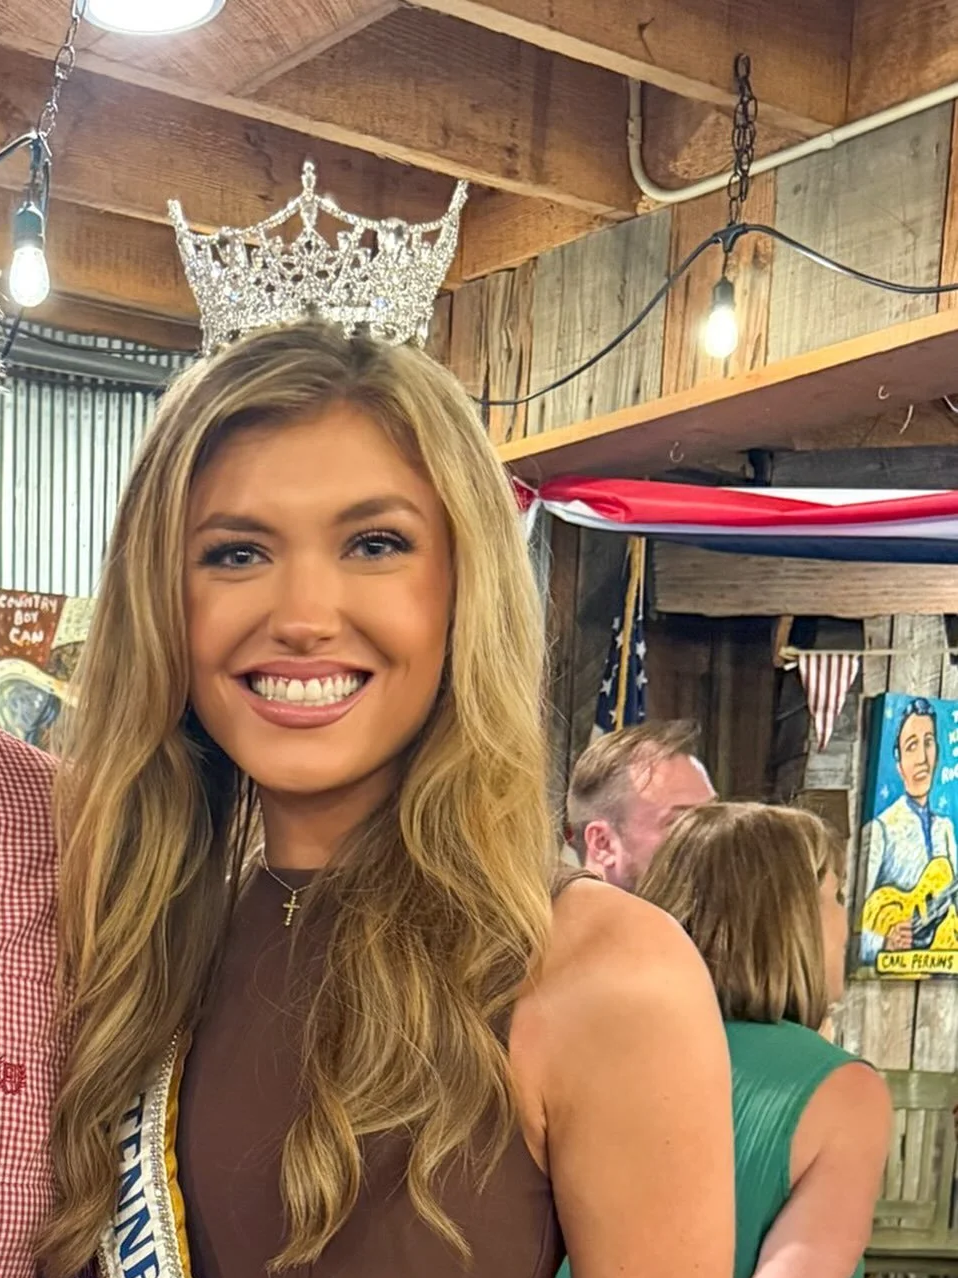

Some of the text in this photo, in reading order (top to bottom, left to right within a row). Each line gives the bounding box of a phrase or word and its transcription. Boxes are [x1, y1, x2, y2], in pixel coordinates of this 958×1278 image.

[14, 609, 39, 626] BOY
[9, 627, 44, 646] CAN
[912, 954, 954, 969] PERKINS
